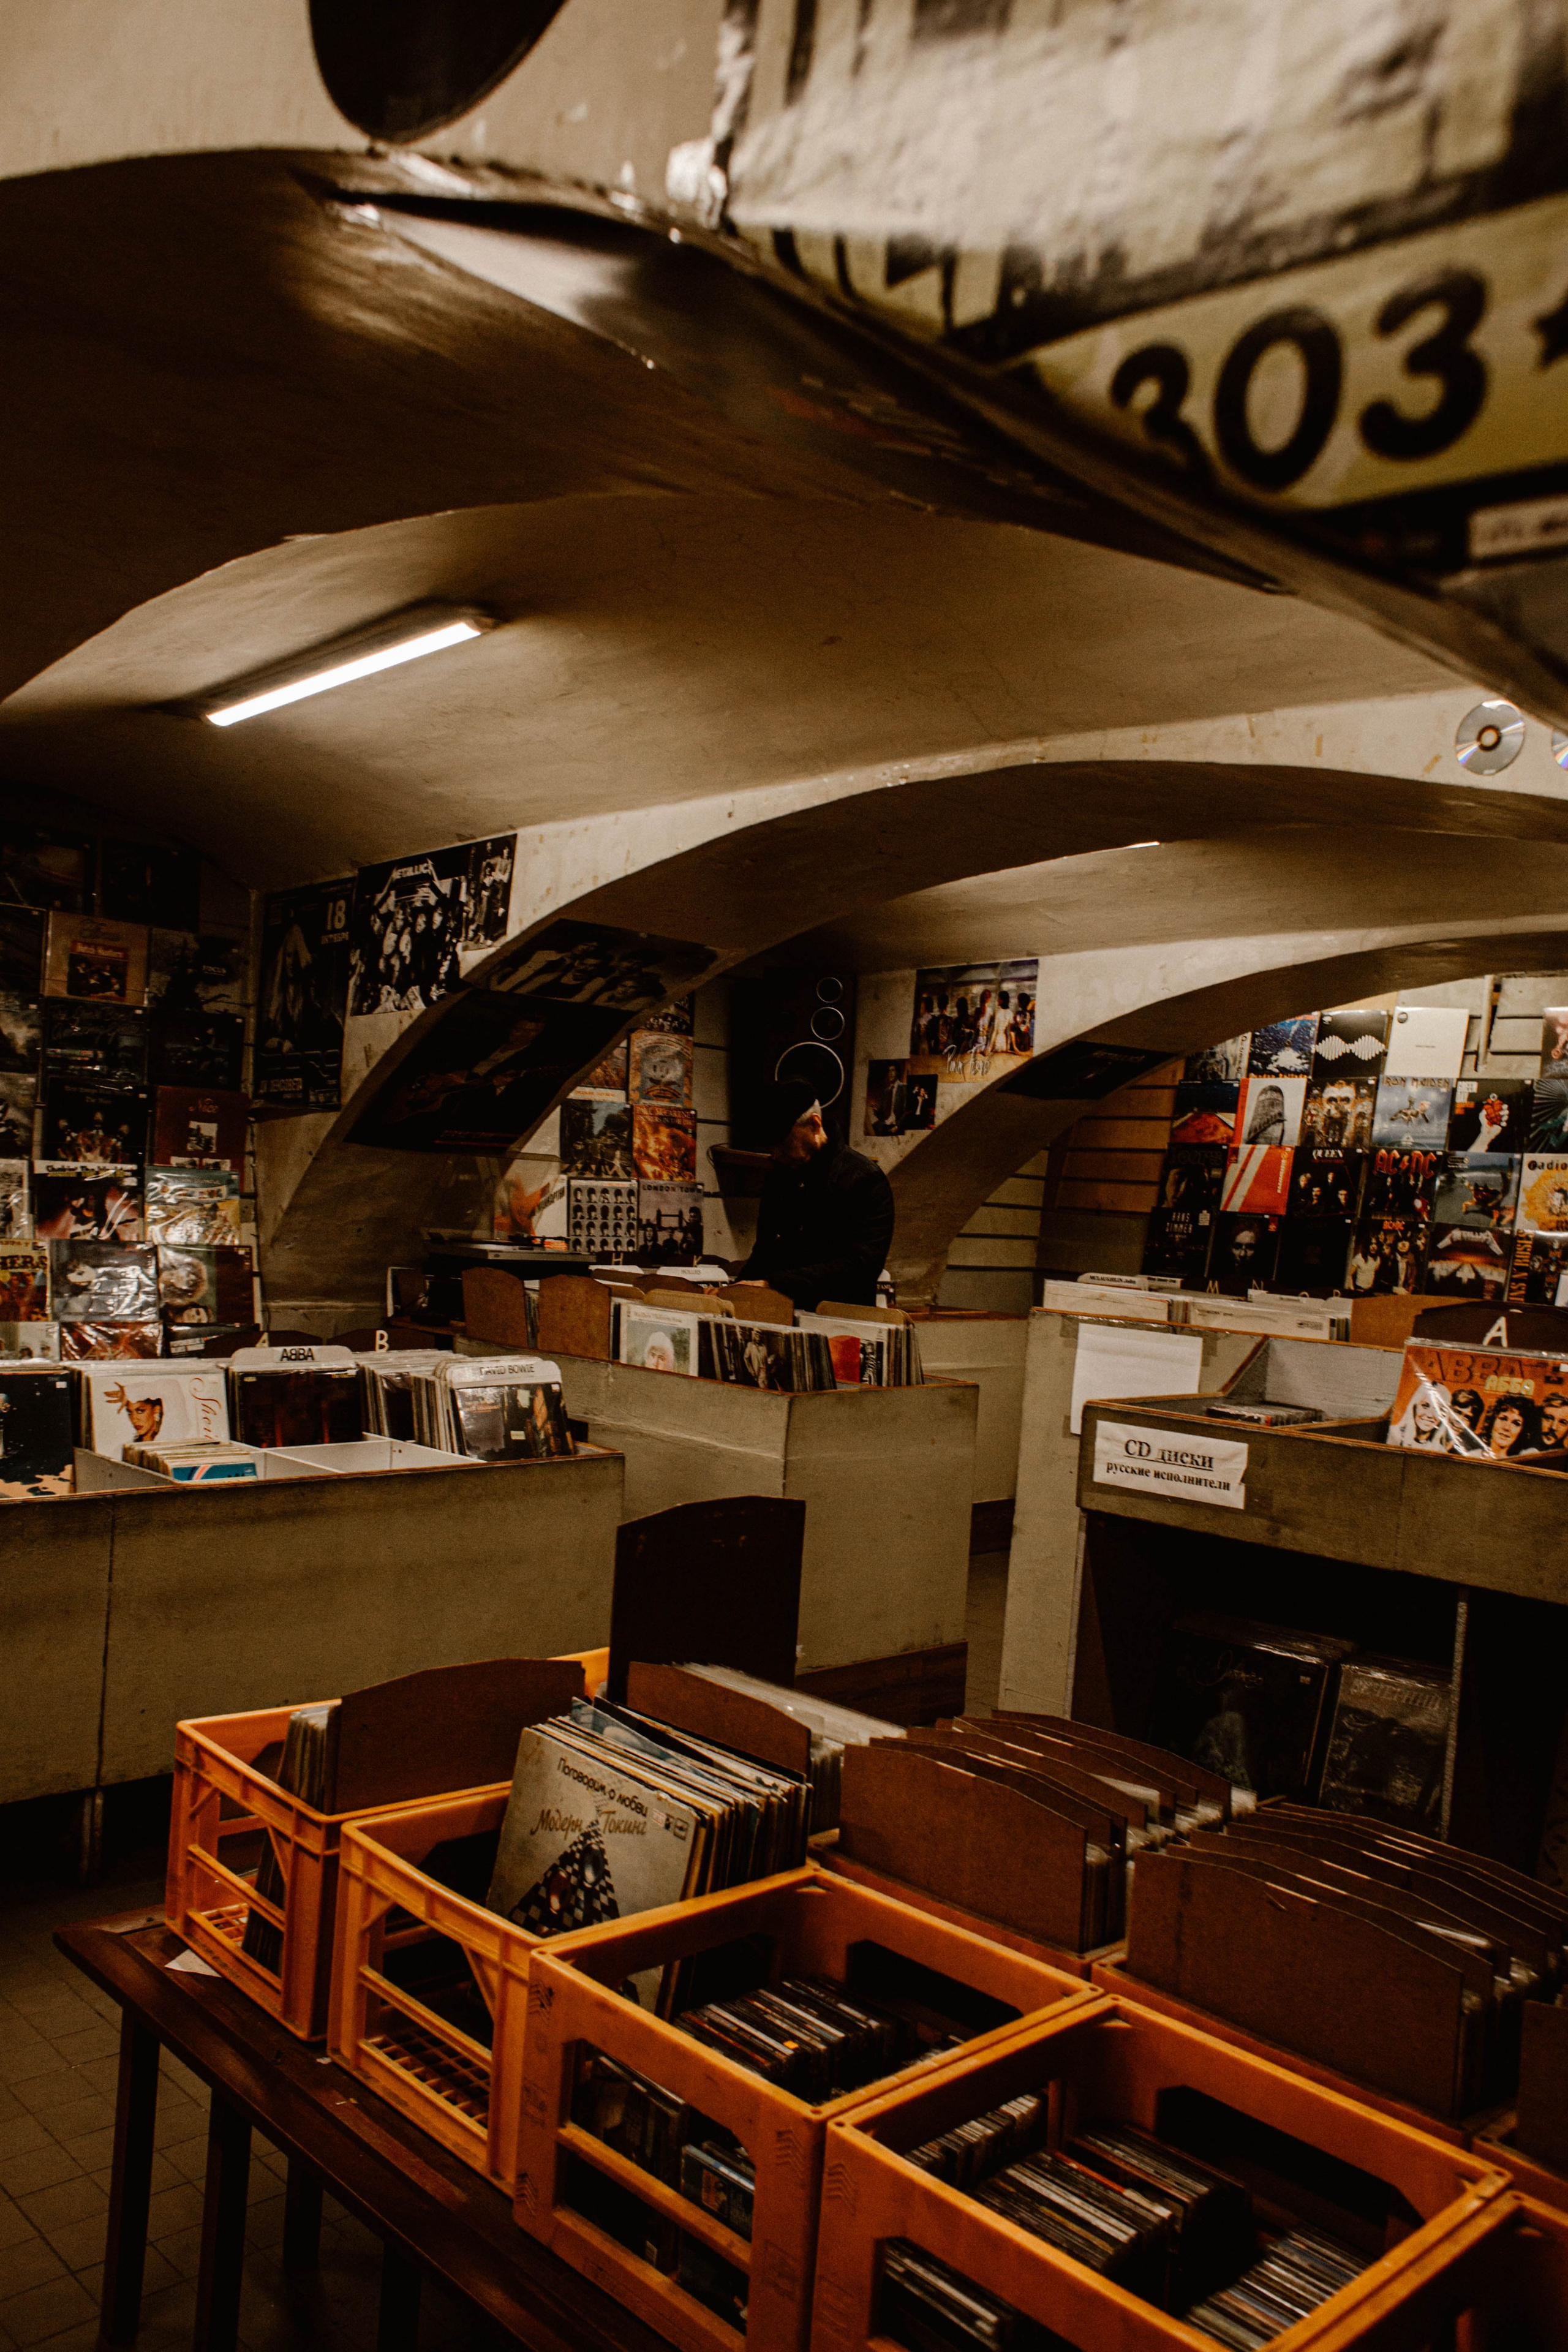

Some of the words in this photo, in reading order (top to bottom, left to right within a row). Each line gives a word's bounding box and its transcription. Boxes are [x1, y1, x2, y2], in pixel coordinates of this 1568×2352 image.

[326, 899, 347, 931] 18
[1382, 1076, 1407, 1088] IRON
[1411, 1076, 1450, 1091] MAIDEN
[1312, 1148, 1343, 1159] QUEEN
[642, 1184, 676, 1193] LONDON
[1513, 1229, 1534, 1266] ROSES
[1206, 1279, 1219, 1294] M
[255, 1332, 270, 1347] A
[375, 1330, 390, 1351] B
[1482, 1316, 1508, 1348] A
[280, 1348, 315, 1361] ABBA
[480, 1366, 506, 1376] DAVID
[508, 1363, 535, 1374] BOWIE
[1422, 1350, 1525, 1387] ABBA
[1124, 1439, 1151, 1457] CD
[1156, 1448, 1214, 1469] диски
[1106, 1461, 1151, 1477] русские
[1153, 1470, 1231, 1491] исполнители
[557, 1757, 607, 1796] Поговорим
[608, 1790, 616, 1799] о
[617, 1793, 649, 1817] любви
[530, 1807, 583, 1839] Модерн
[600, 1810, 647, 1836] Токинг
